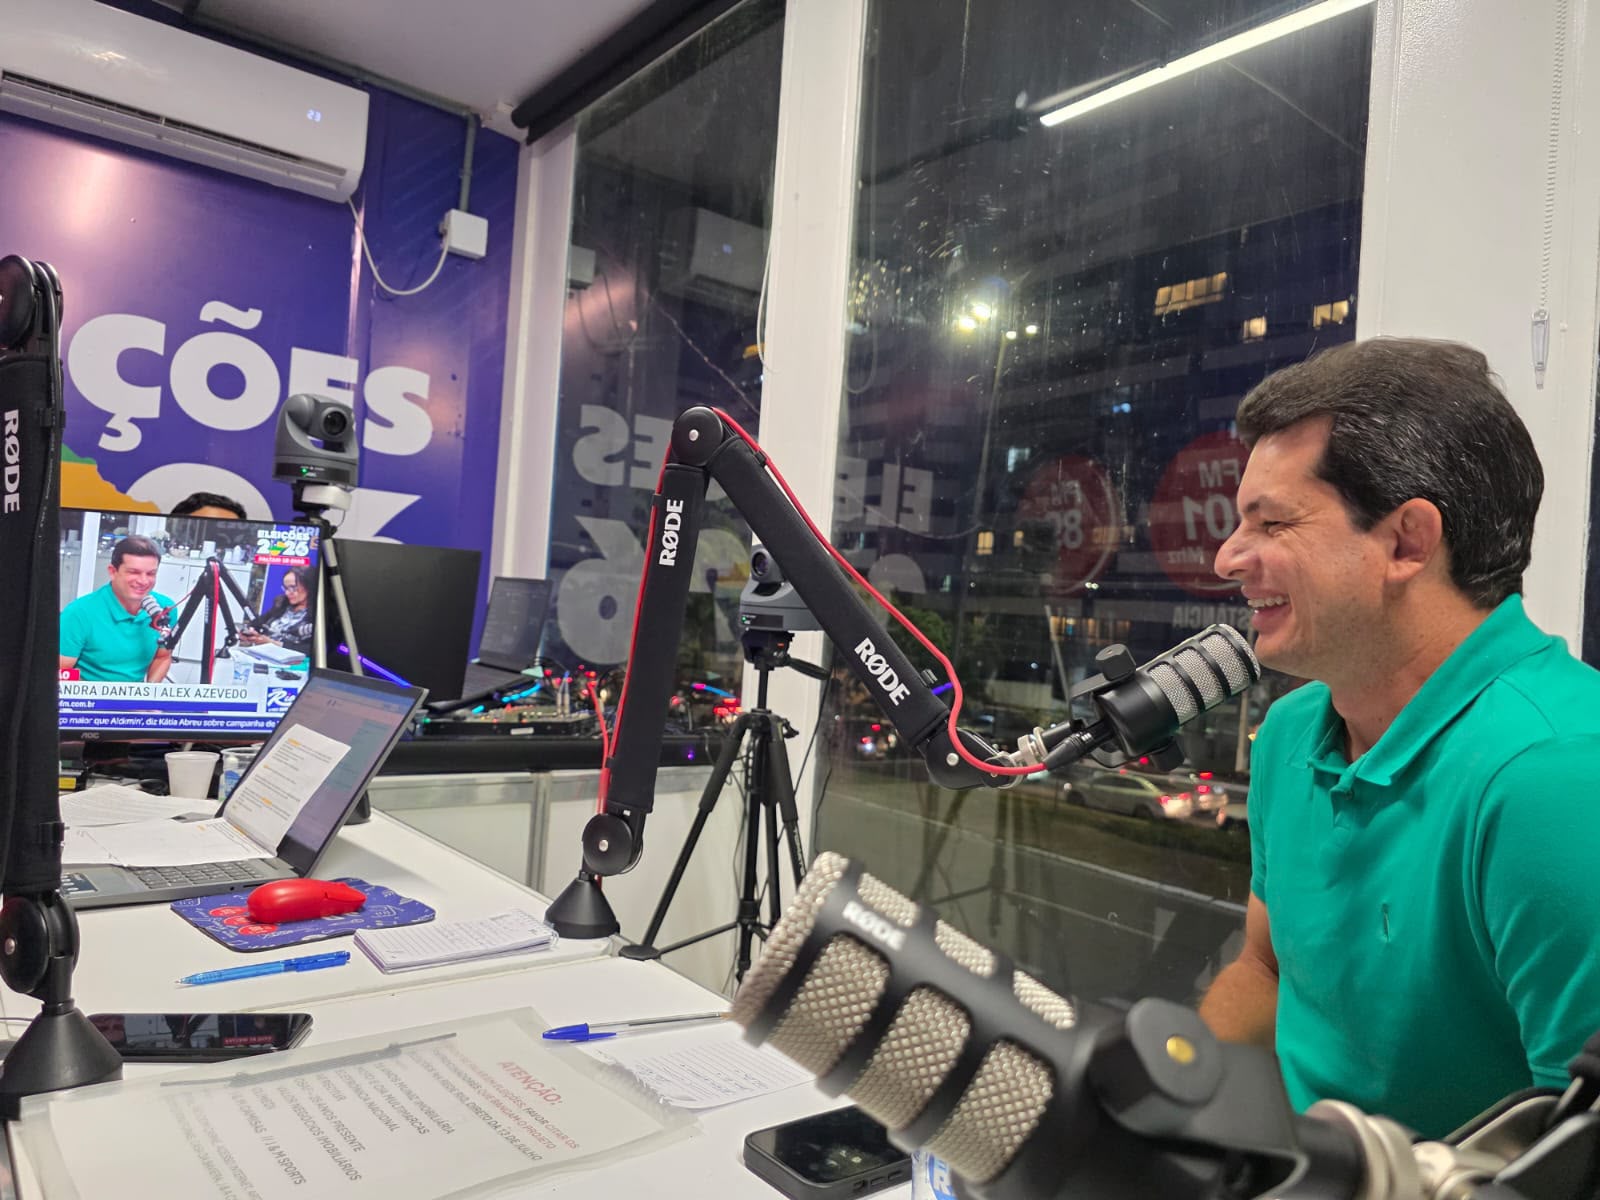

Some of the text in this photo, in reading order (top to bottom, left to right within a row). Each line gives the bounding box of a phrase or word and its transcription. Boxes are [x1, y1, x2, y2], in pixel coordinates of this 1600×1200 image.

[306, 108, 322, 122] 23
[4, 409, 21, 514] RØDE
[256, 529, 311, 541] ELEIÇÕES
[658, 498, 685, 567] RØDE
[853, 637, 912, 708] RØDE
[101, 685, 151, 698] DANTAS
[160, 686, 191, 698] ALEX
[194, 687, 248, 699] AZEVEDO
[69, 717, 93, 725] maior
[94, 718, 110, 726] que
[145, 718, 157, 726] diz
[178, 718, 202, 727] Abreu
[203, 718, 225, 727] sobre
[226, 720, 264, 728] campanha
[498, 1060, 563, 1106] ATENÇÃO:
[363, 1100, 404, 1132] NACIONAL
[464, 1101, 496, 1121] DIRETO
[520, 1106, 552, 1125] FAVOR
[486, 1119, 507, 1130] DA
[329, 1119, 367, 1153] PRESENTE
[504, 1134, 524, 1144] DE
[520, 1124, 560, 1149] PROJETO
[315, 1134, 365, 1181] IMOBILIÁRIOS
[513, 1142, 545, 1161] JULHO
[275, 1156, 309, 1185] SPORTS
